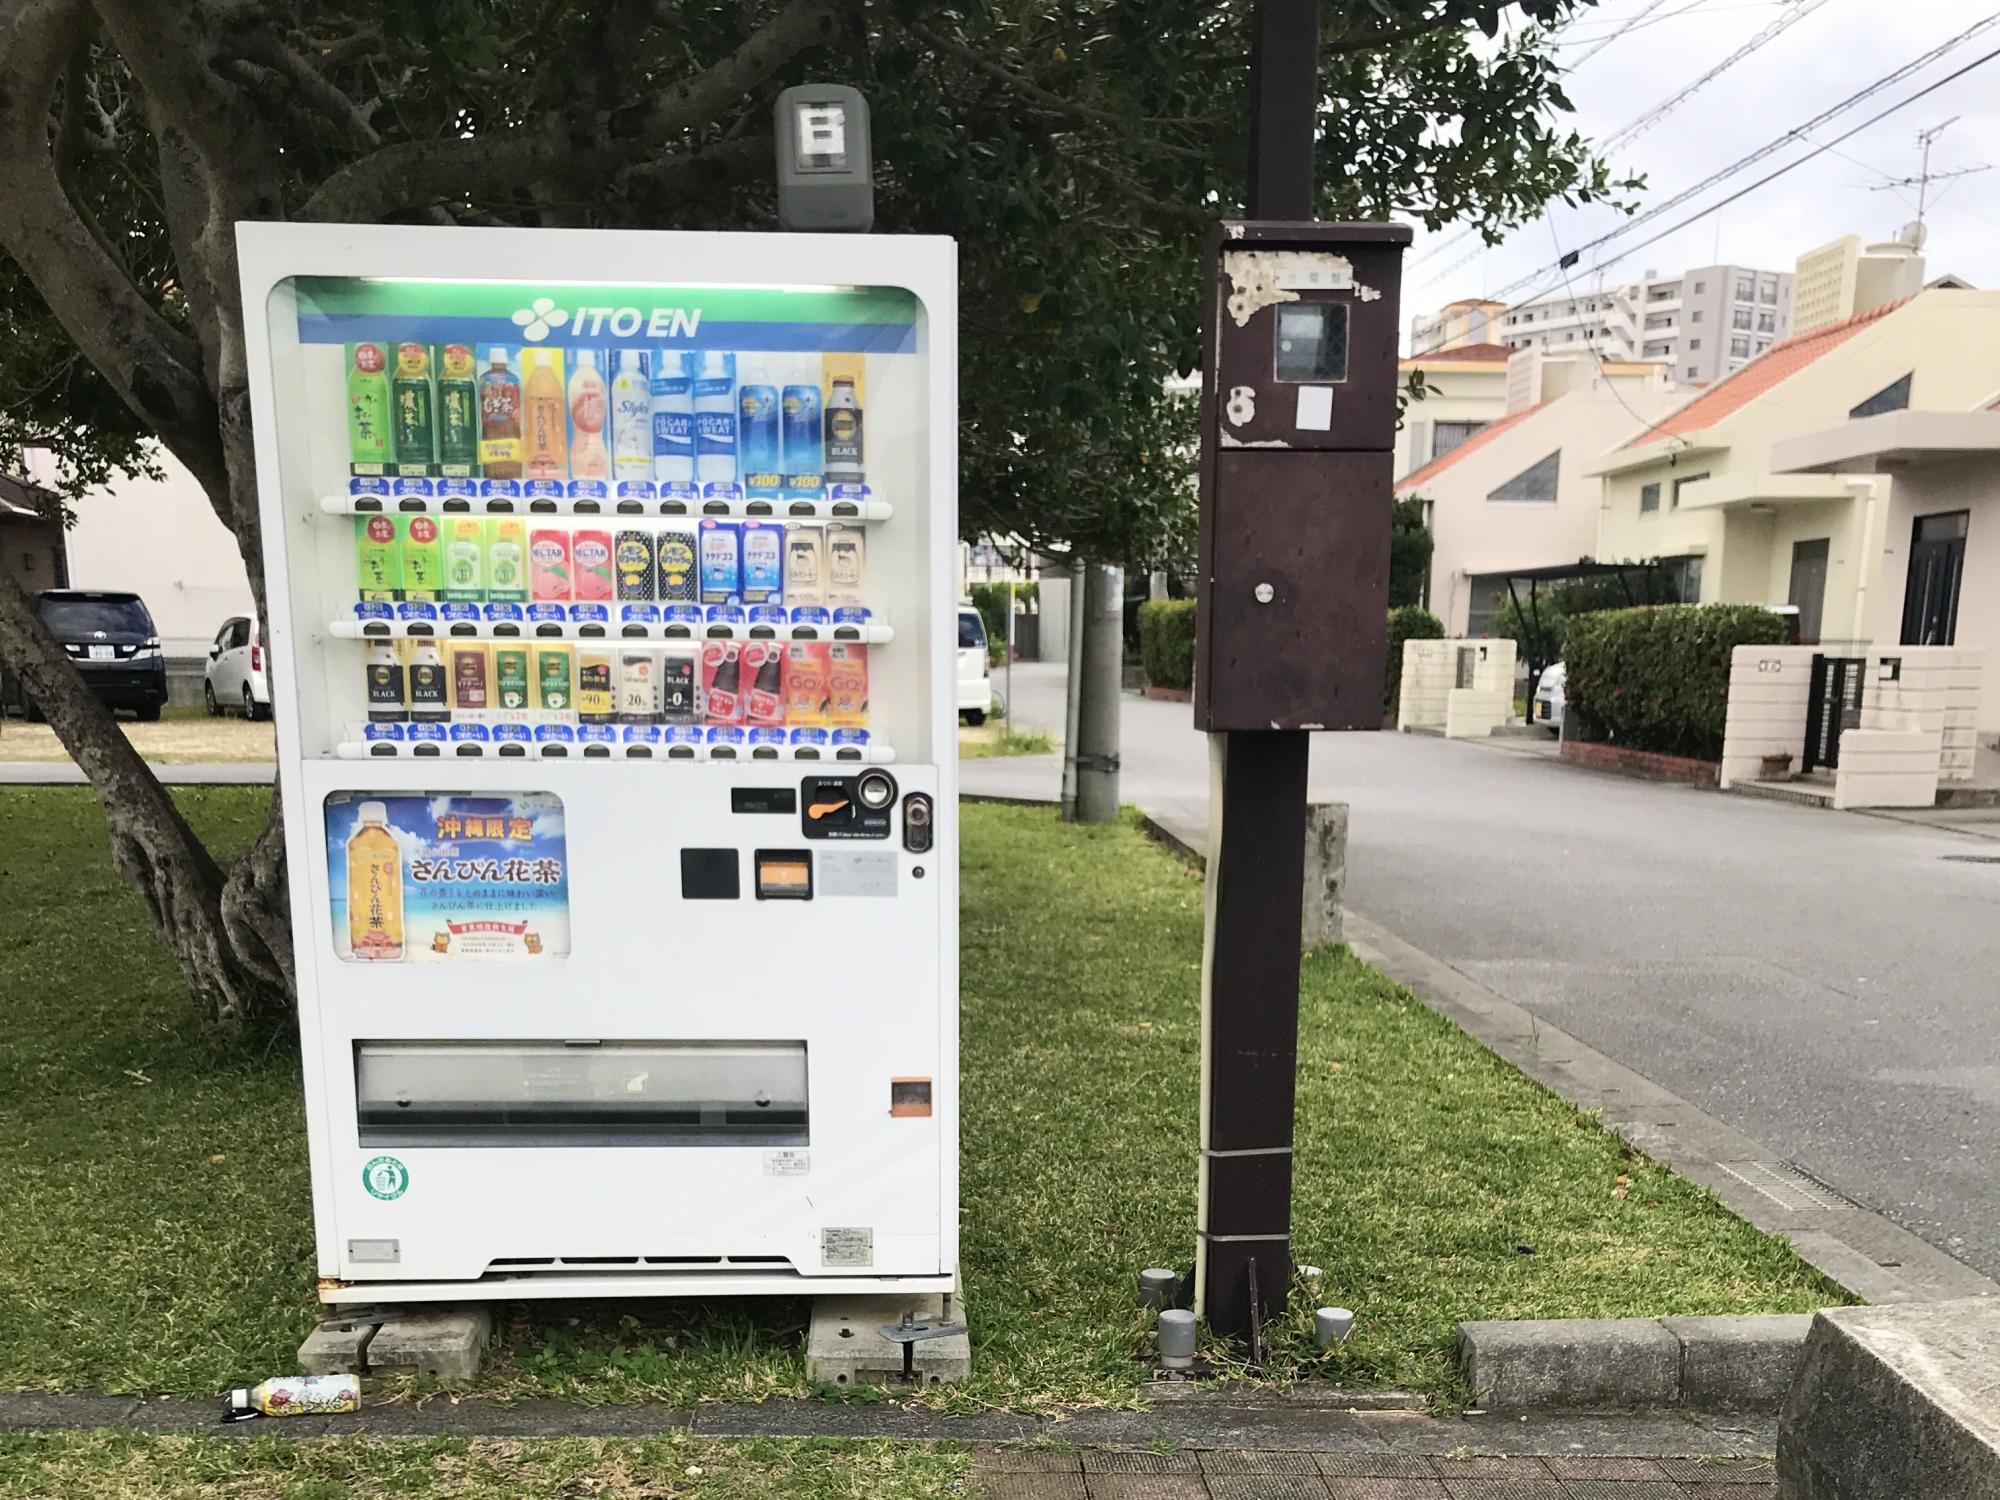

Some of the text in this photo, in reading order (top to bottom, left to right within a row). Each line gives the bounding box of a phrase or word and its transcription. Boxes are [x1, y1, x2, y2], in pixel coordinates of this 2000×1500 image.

[572, 307, 701, 338] ITO EN
[831, 447, 858, 456] BLACK
[415, 690, 438, 698] BLACK
[436, 815, 533, 842] 沖縄限定
[410, 858, 561, 884] さんぴん花茶
